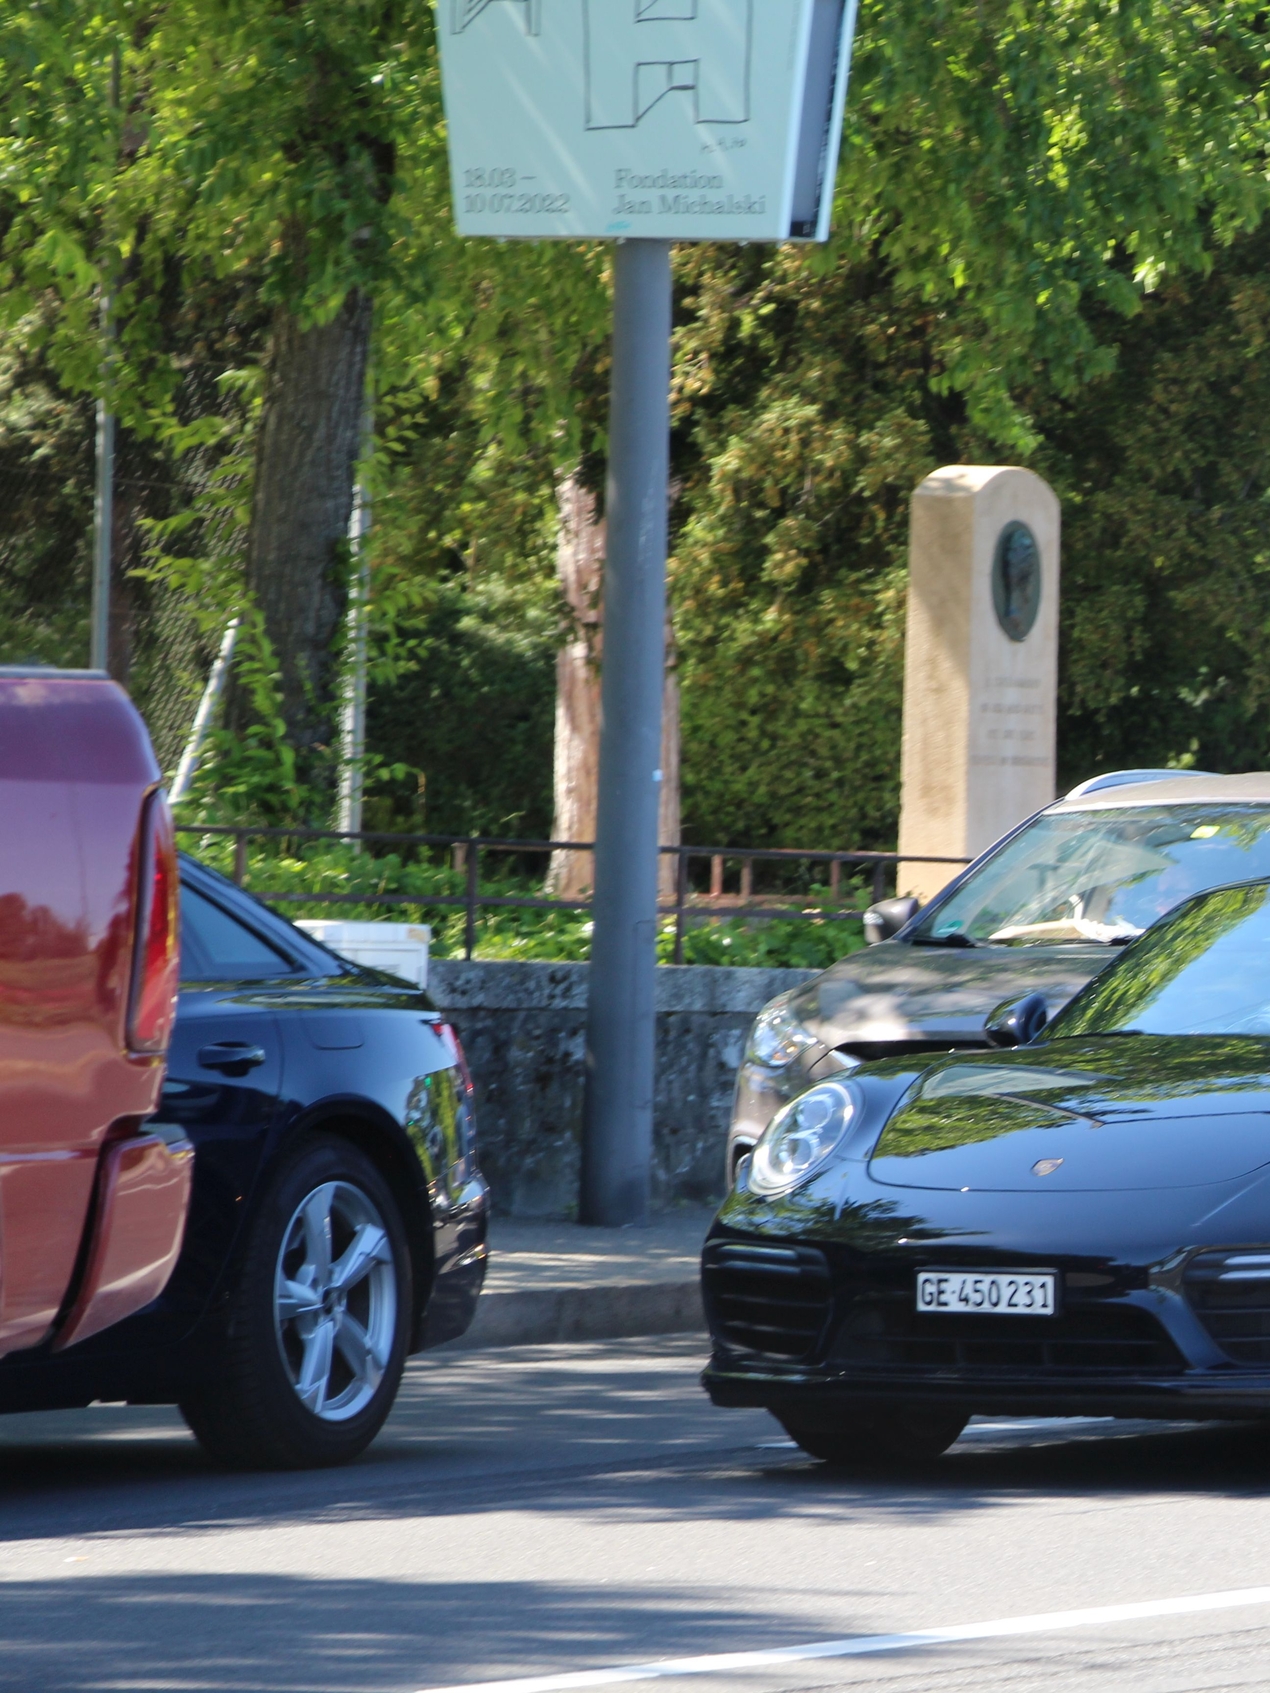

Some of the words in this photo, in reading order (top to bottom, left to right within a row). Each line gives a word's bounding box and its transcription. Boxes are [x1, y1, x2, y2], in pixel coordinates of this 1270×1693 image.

[614, 168, 723, 189] Fondation
[612, 194, 652, 215] Jan
[657, 194, 767, 215] Michalski
